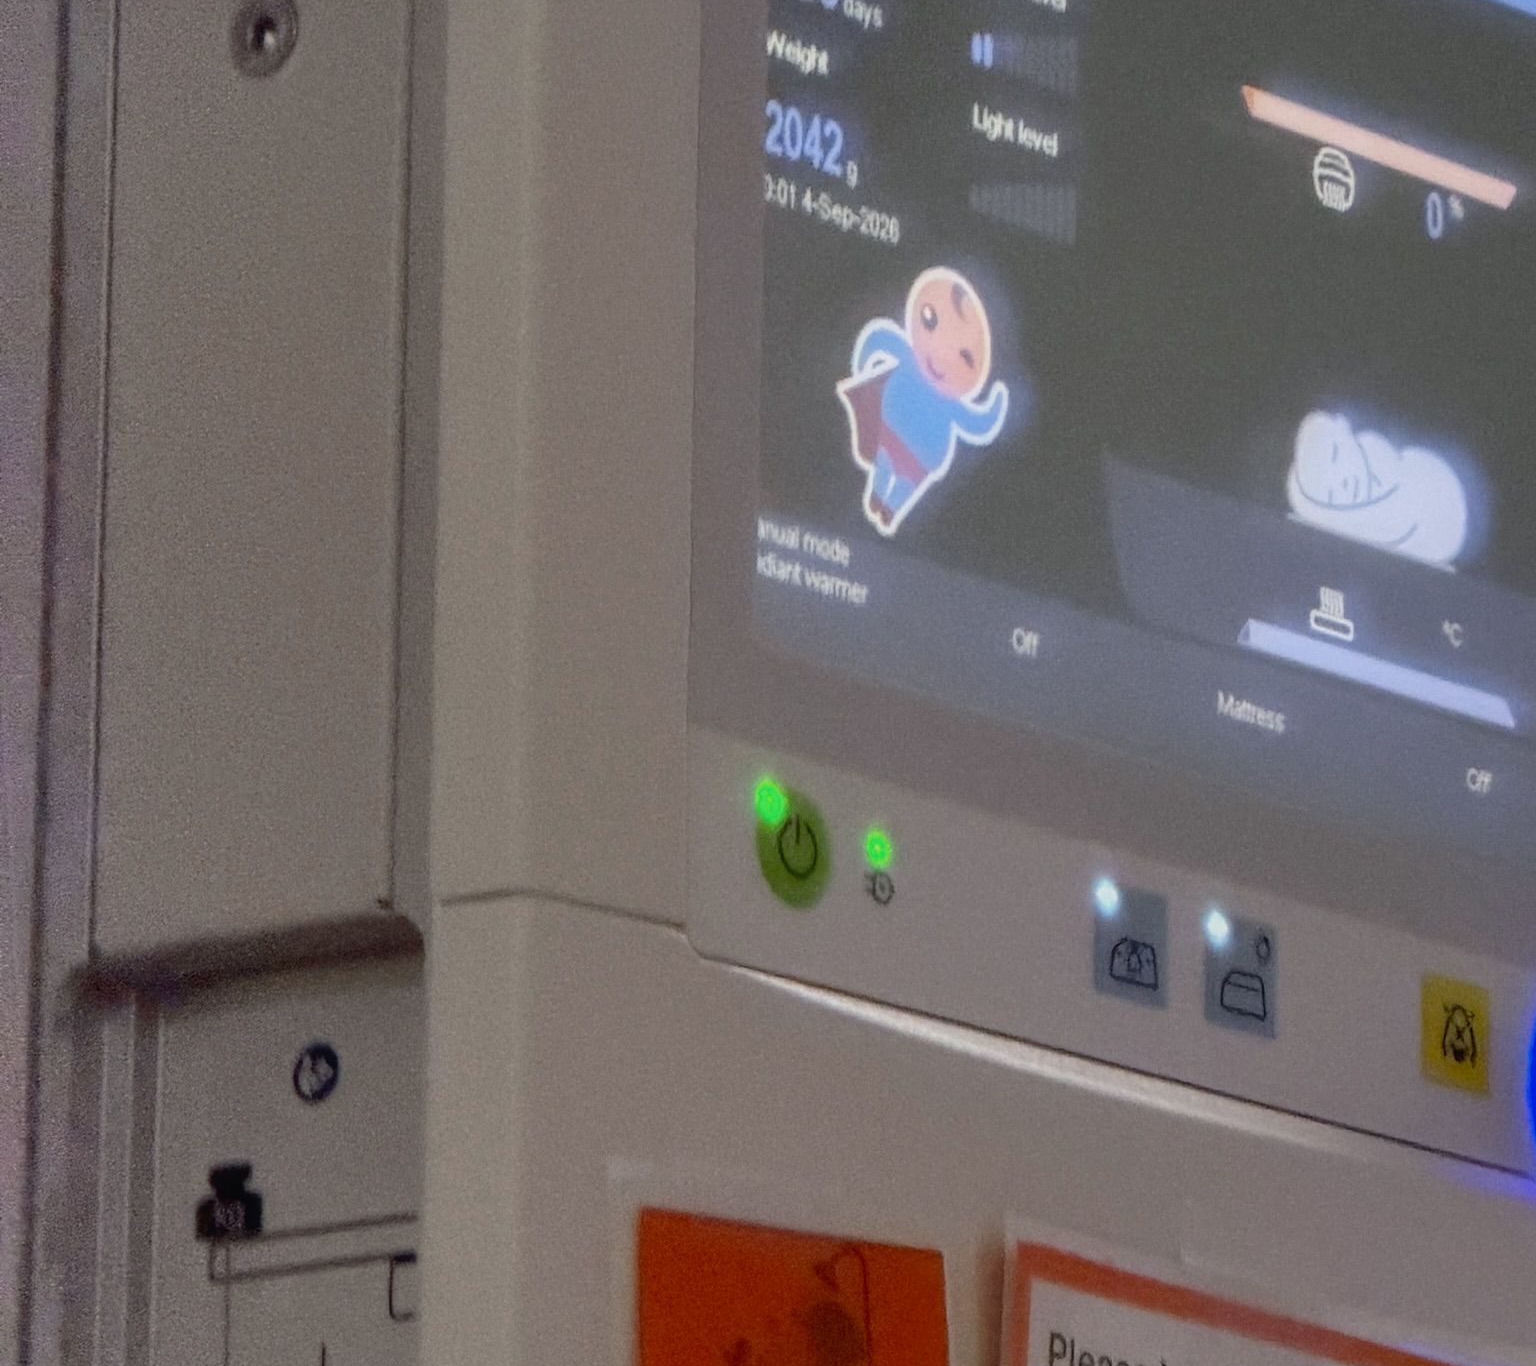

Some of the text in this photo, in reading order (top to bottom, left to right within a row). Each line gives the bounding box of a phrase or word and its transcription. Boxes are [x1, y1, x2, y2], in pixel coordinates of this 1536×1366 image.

[766, 30, 829, 76] Weight
[765, 99, 843, 178] 2042
[973, 101, 1058, 158] Light level
[1426, 191, 1443, 240] 0
[803, 531, 850, 567] mode
[804, 567, 868, 604] warmer
[1012, 627, 1039, 658] Off
[1216, 689, 1286, 734] Mattress
[1466, 767, 1493, 794] Off
